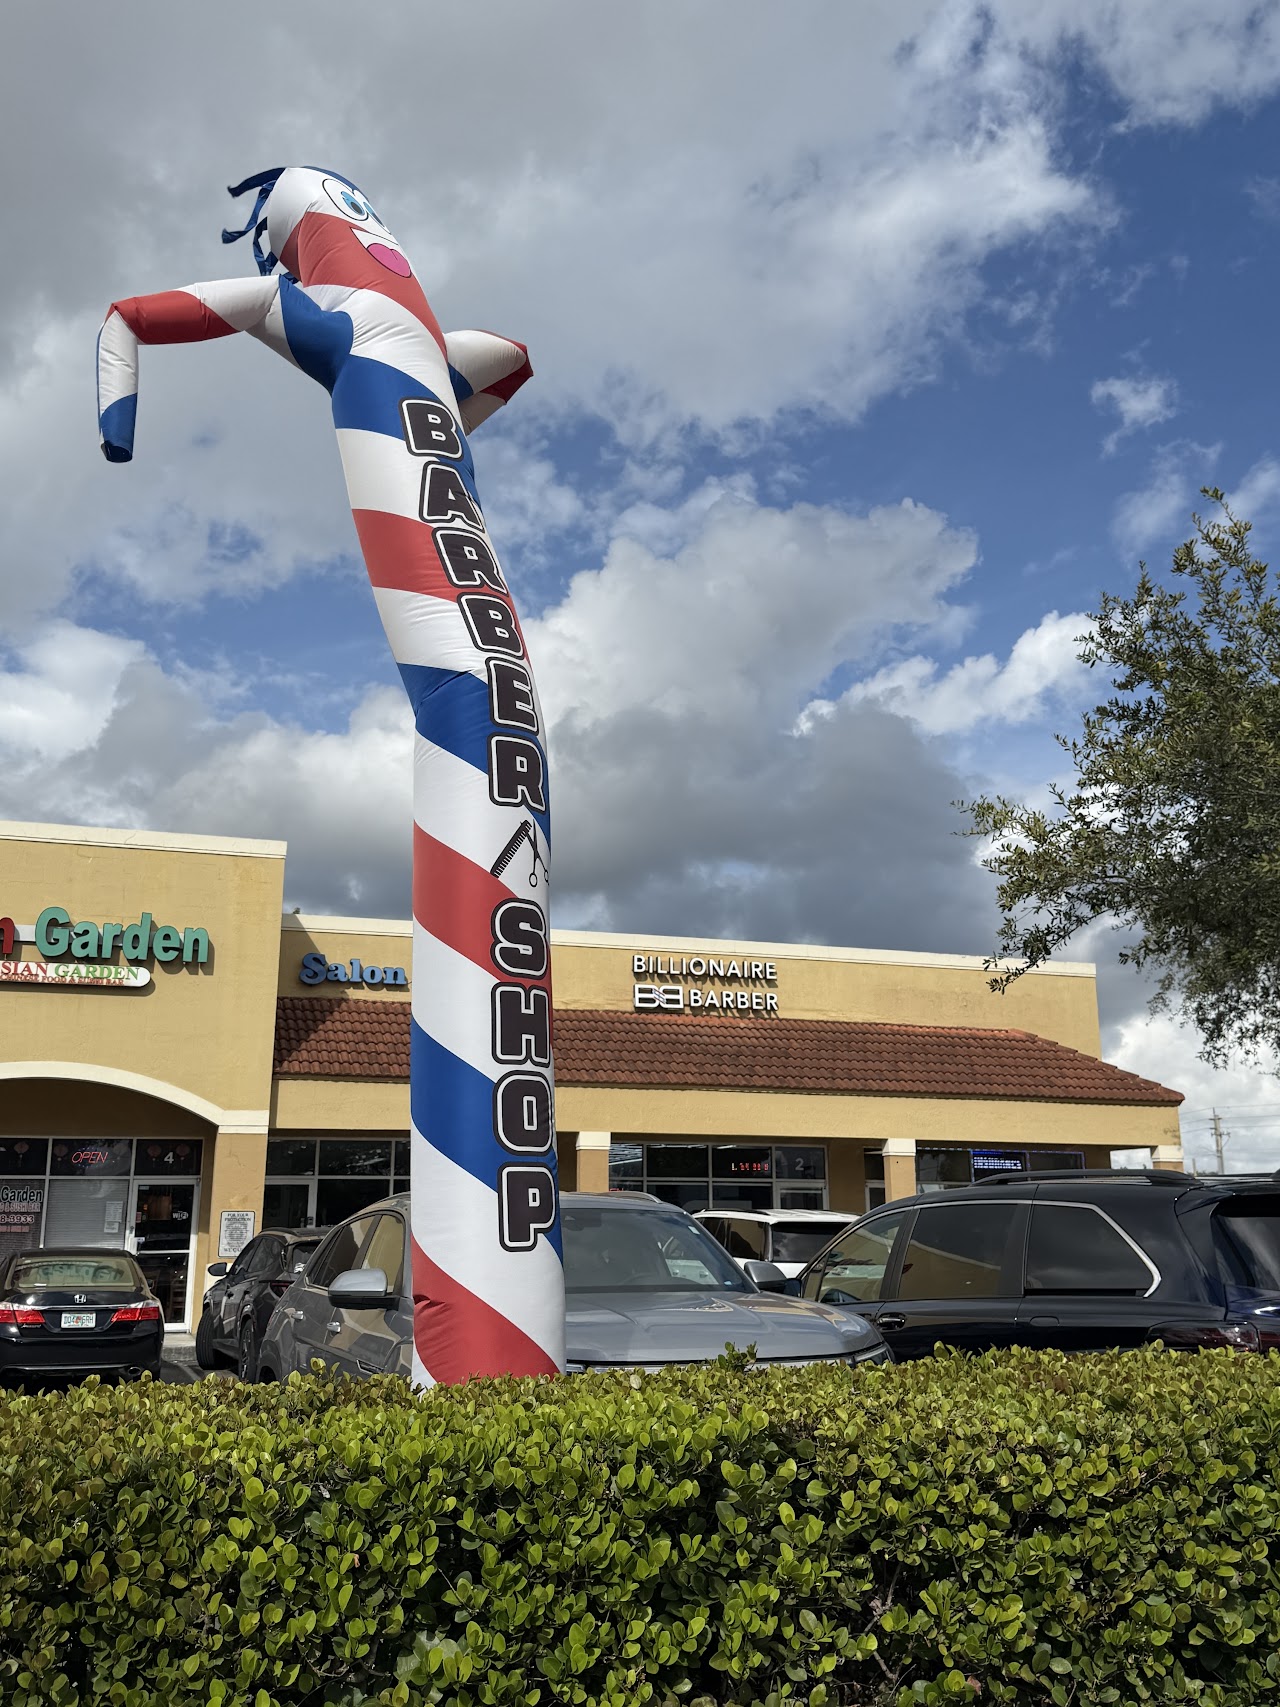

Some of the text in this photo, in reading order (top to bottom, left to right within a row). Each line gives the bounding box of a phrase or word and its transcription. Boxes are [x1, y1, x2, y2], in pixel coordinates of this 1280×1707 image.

[398, 397, 557, 1253] BARBER SHOP
[35, 906, 209, 963] Garden
[54, 964, 140, 980] GARDEN
[300, 952, 407, 985] Salon
[633, 955, 778, 980] BILLIONAIRE
[689, 989, 778, 1011] BARBER
[71, 1151, 108, 1164] OPEN
[164, 1152, 174, 1164] 4
[795, 1157, 804, 1170] 2
[1, 1185, 43, 1202] Garden
